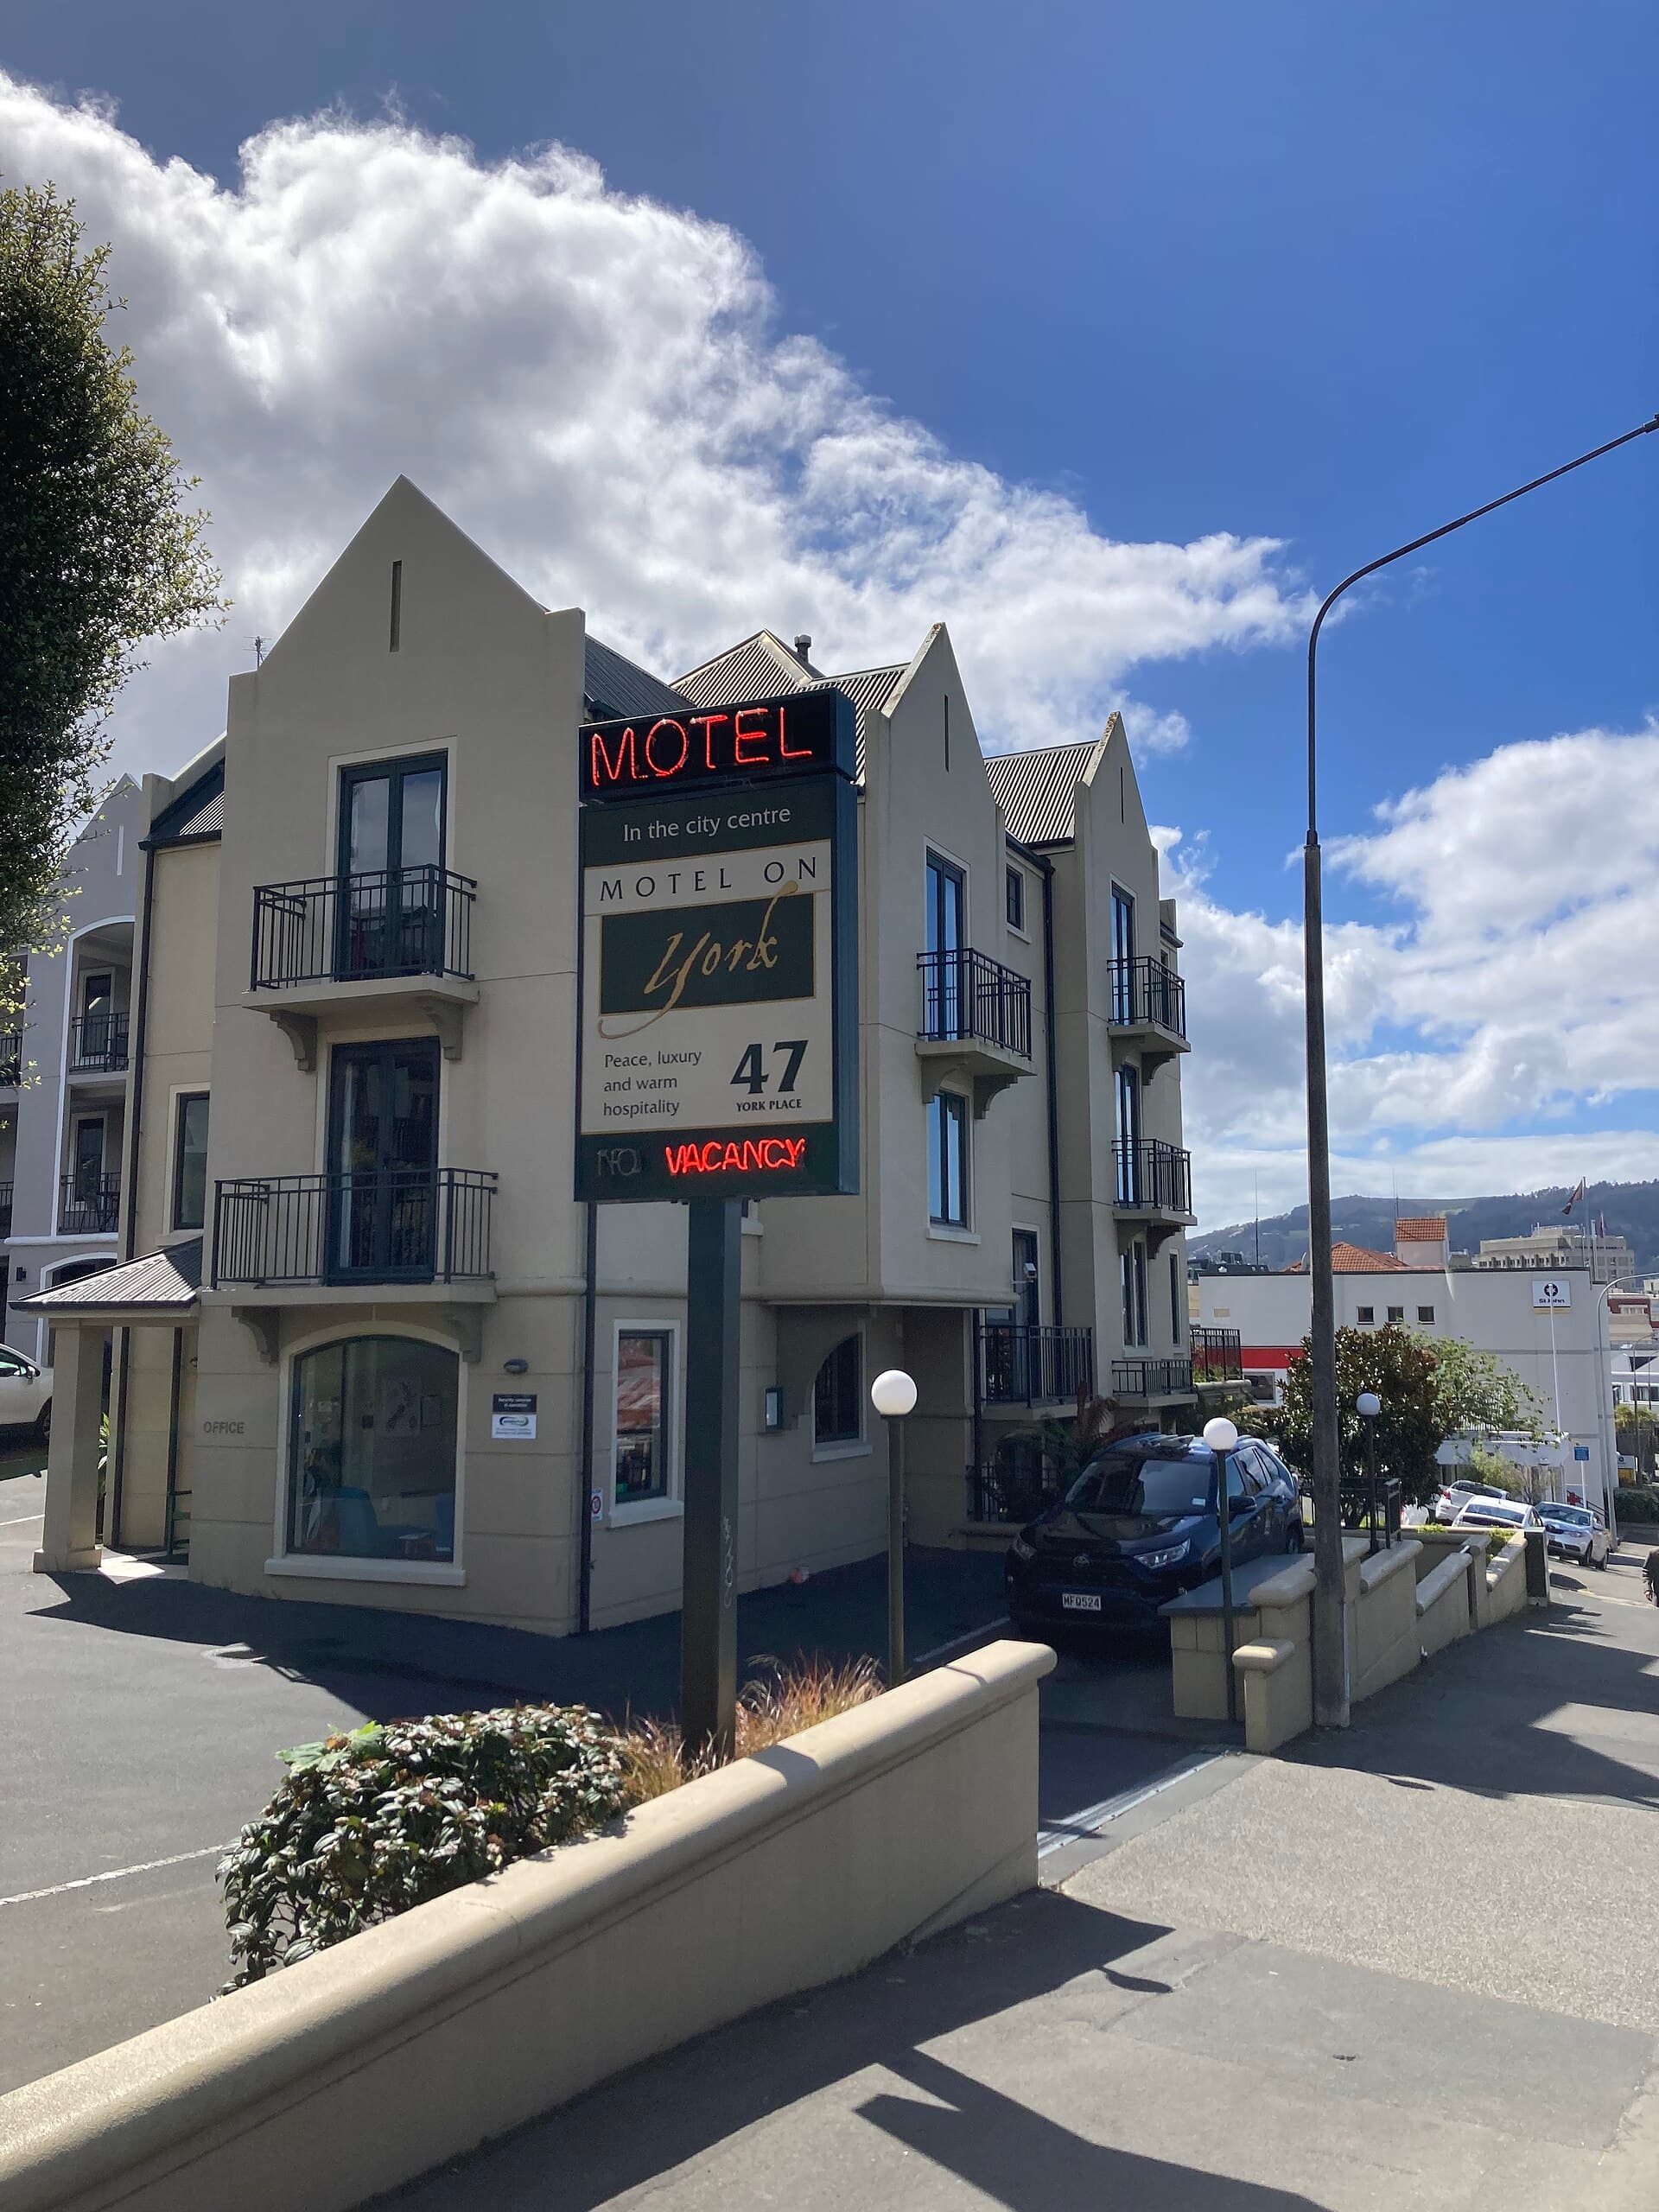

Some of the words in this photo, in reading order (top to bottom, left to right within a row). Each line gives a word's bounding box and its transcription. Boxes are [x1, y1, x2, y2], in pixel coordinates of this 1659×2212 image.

[592, 707, 813, 787] MOTEL
[624, 823, 641, 842] In
[648, 820, 679, 838] the
[685, 816, 720, 836] city
[728, 807, 791, 830] centre
[600, 868, 732, 902] MOTEL
[764, 856, 816, 884] ON
[604, 1053, 652, 1068] Peace,
[658, 1051, 702, 1065] luxury
[729, 1039, 809, 1095] 47
[604, 1077, 632, 1092] and
[636, 1077, 677, 1090] warm
[603, 1100, 681, 1118] hospitality
[736, 1100, 766, 1112] YORK
[769, 1098, 802, 1109] PLACE
[596, 1147, 641, 1176] NO
[665, 1138, 805, 1175] VACANCY
[203, 1421, 245, 1434] OFFICE
